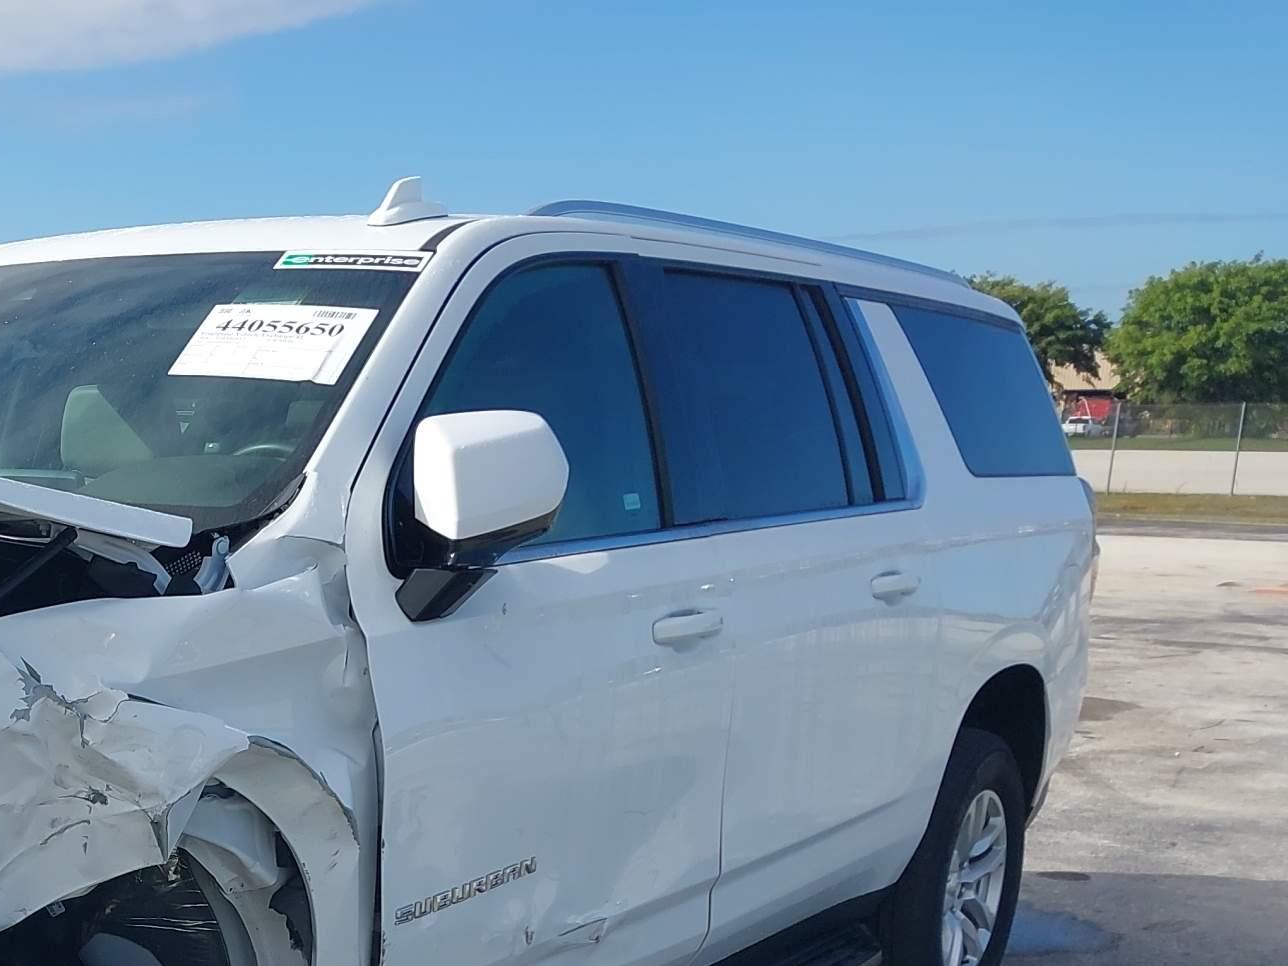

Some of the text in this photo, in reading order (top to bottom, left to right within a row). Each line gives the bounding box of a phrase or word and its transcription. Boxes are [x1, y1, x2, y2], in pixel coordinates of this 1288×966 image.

[289, 254, 421, 266] enterprise
[215, 319, 345, 338] 44055650
[394, 856, 537, 926] SUBURBAN
